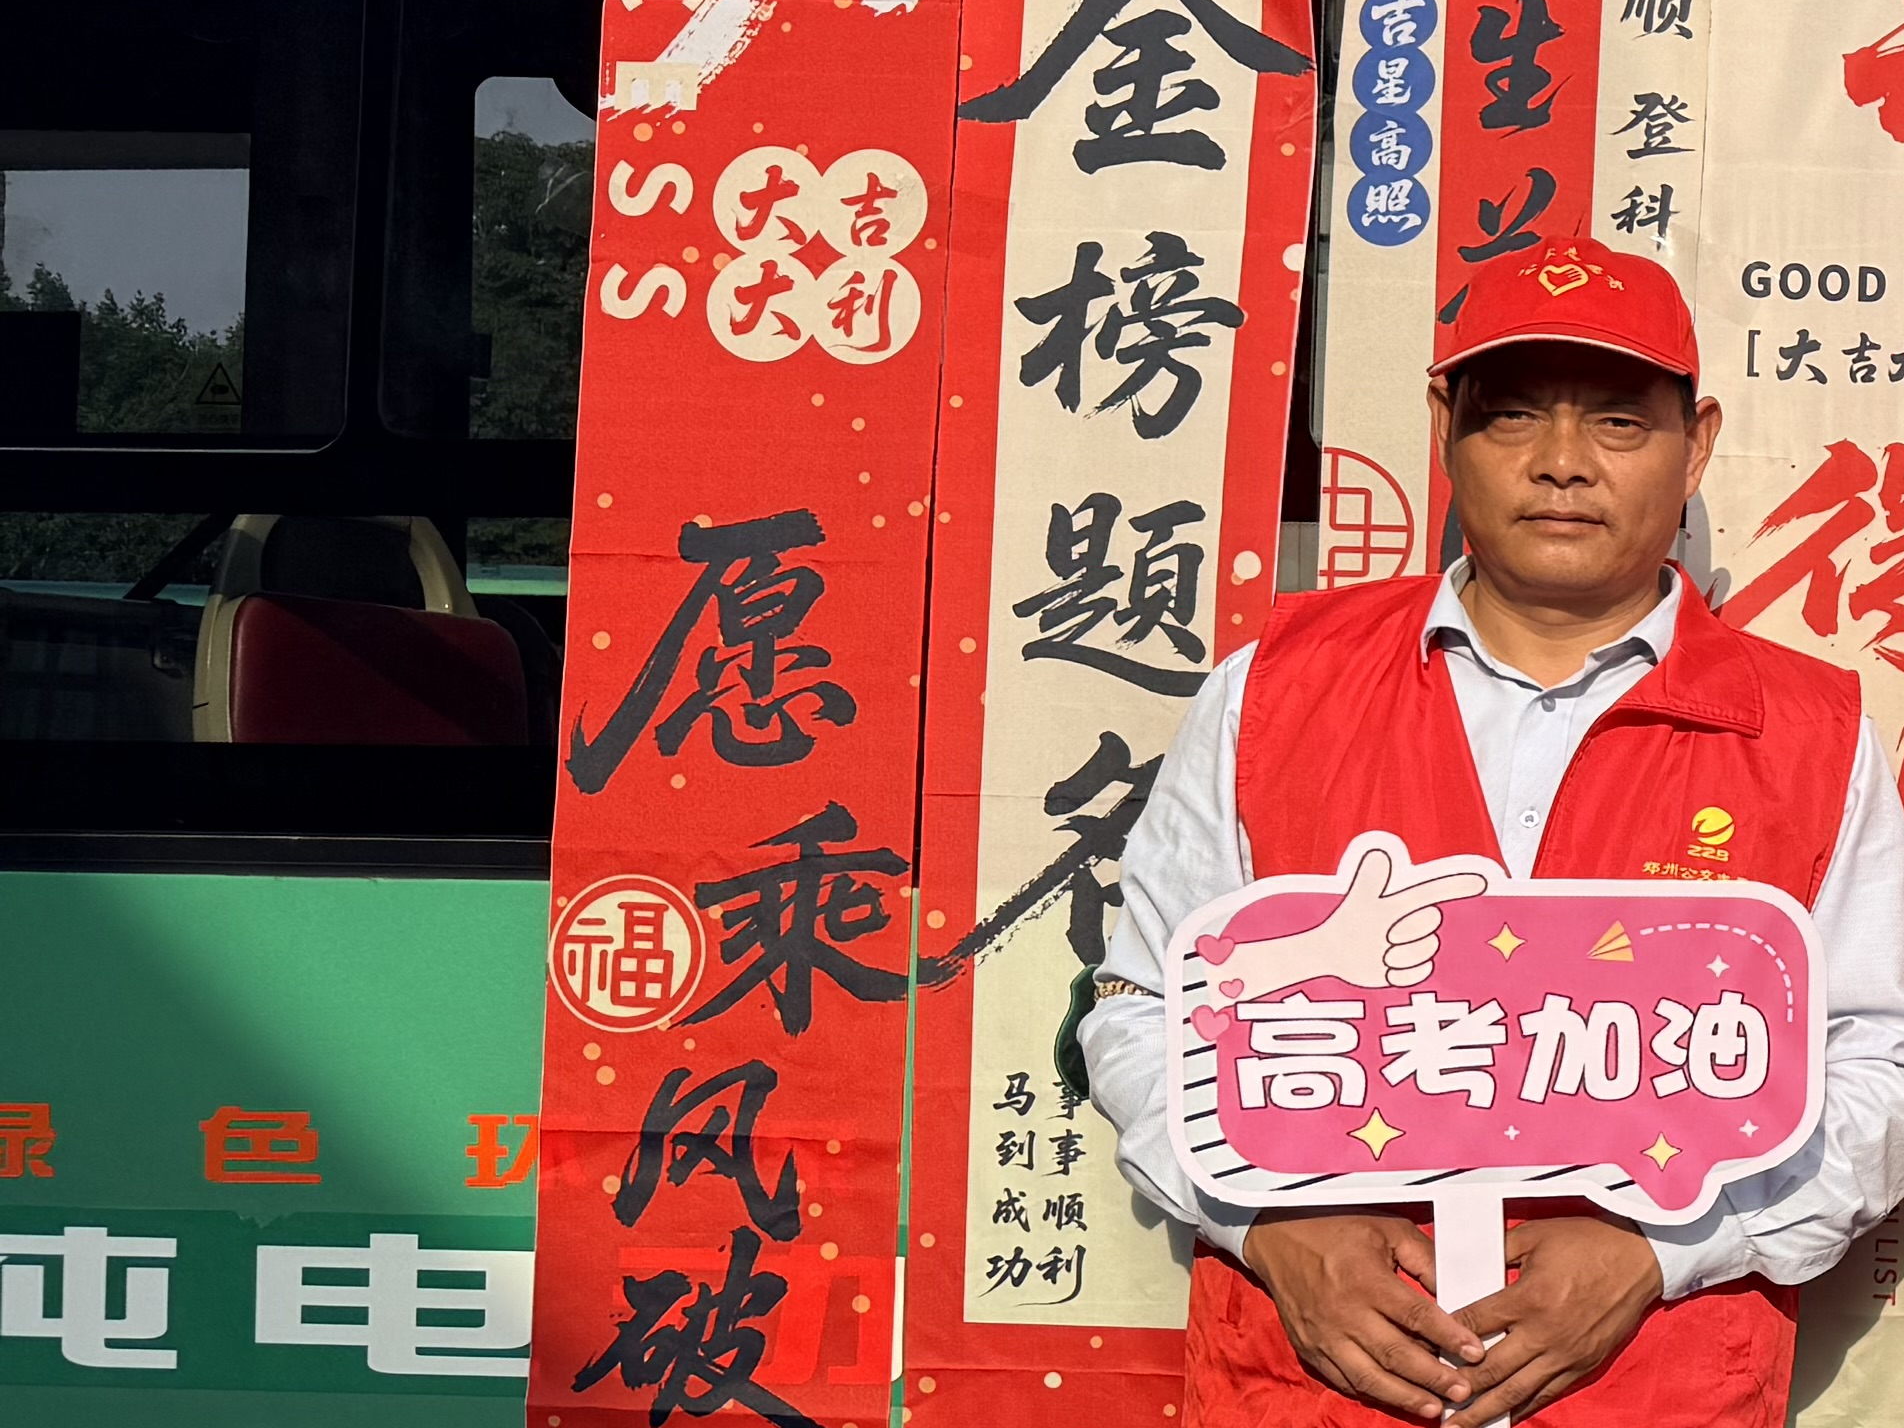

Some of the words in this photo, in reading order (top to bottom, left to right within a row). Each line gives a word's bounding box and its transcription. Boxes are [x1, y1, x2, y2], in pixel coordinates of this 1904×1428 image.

[1742, 262, 1887, 310] GOOD
[563, 902, 691, 1014] 福
[1234, 989, 1772, 1113] 高考加油
[978, 1071, 1036, 1298] 马到成功
[1872, 1238, 1899, 1307] LIST
